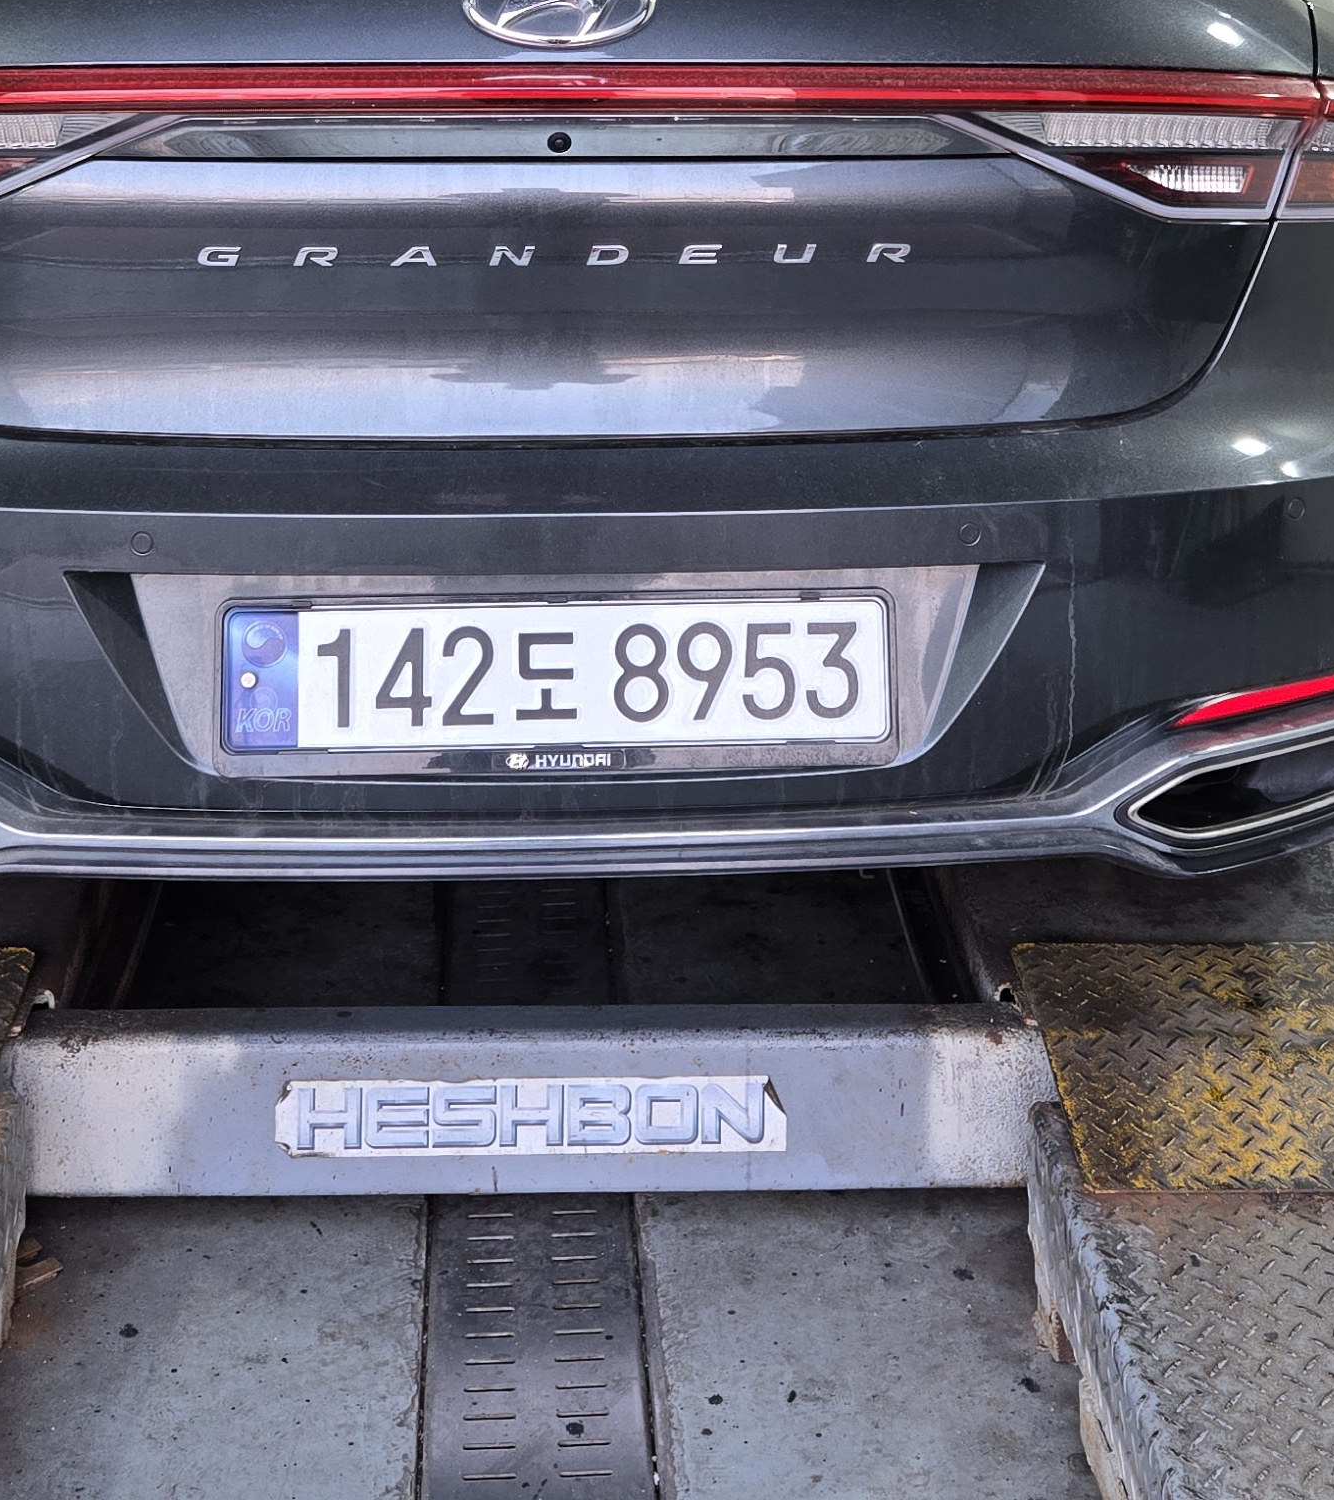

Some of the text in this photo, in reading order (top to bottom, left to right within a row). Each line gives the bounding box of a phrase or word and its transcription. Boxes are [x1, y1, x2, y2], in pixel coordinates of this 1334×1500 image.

[197, 242, 911, 268] GRANDEUR
[316, 621, 860, 729] 142도 8953
[235, 707, 292, 733] KOR
[535, 753, 611, 768] HYUNDAI
[296, 1083, 765, 1150] HESHBON
